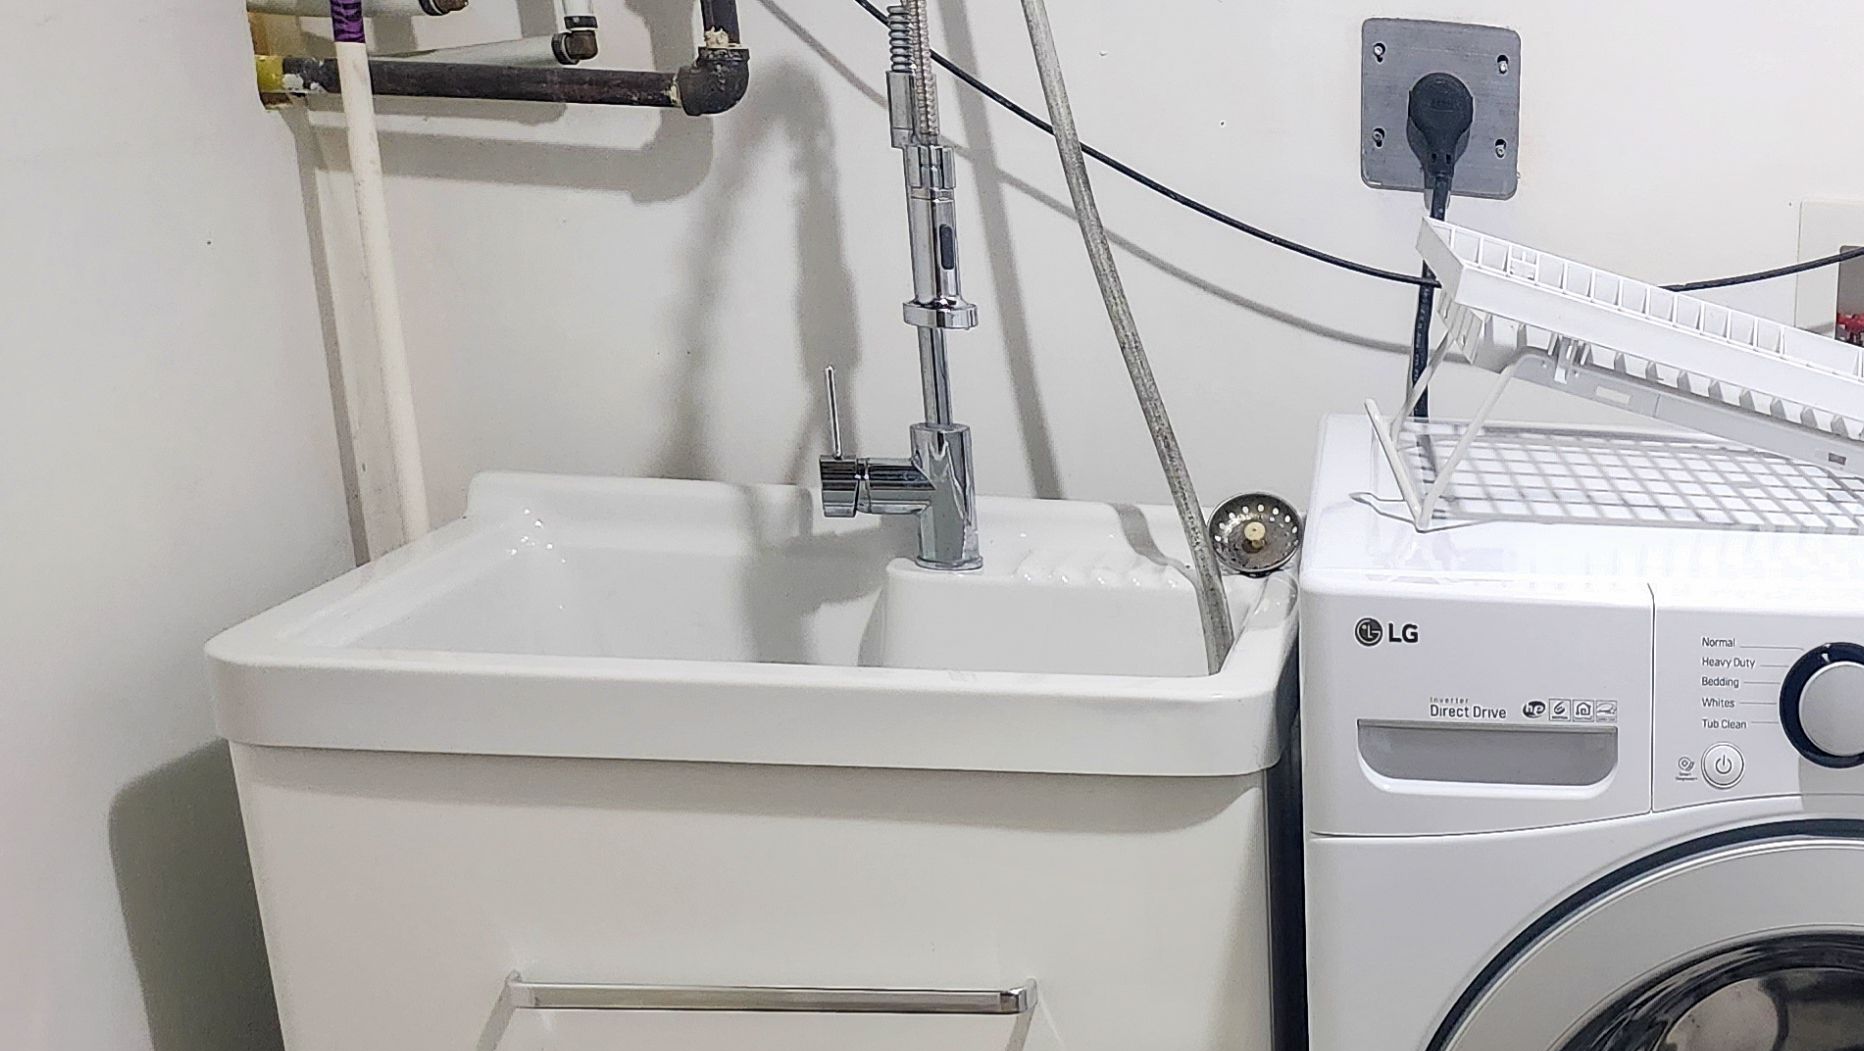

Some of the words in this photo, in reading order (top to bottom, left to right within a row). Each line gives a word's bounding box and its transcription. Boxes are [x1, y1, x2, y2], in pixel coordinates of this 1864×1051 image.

[1388, 623, 1419, 643] LG
[1702, 637, 1735, 648] Normal
[1702, 657, 1731, 669] Heavy
[1733, 657, 1756, 670] Duty
[1702, 677, 1739, 688] Bedding
[1702, 698, 1735, 708] Whites
[1430, 704, 1469, 718] Direct
[1473, 705, 1507, 719] Drive
[1702, 719, 1718, 729] Tub
[1721, 719, 1747, 729] Clean
